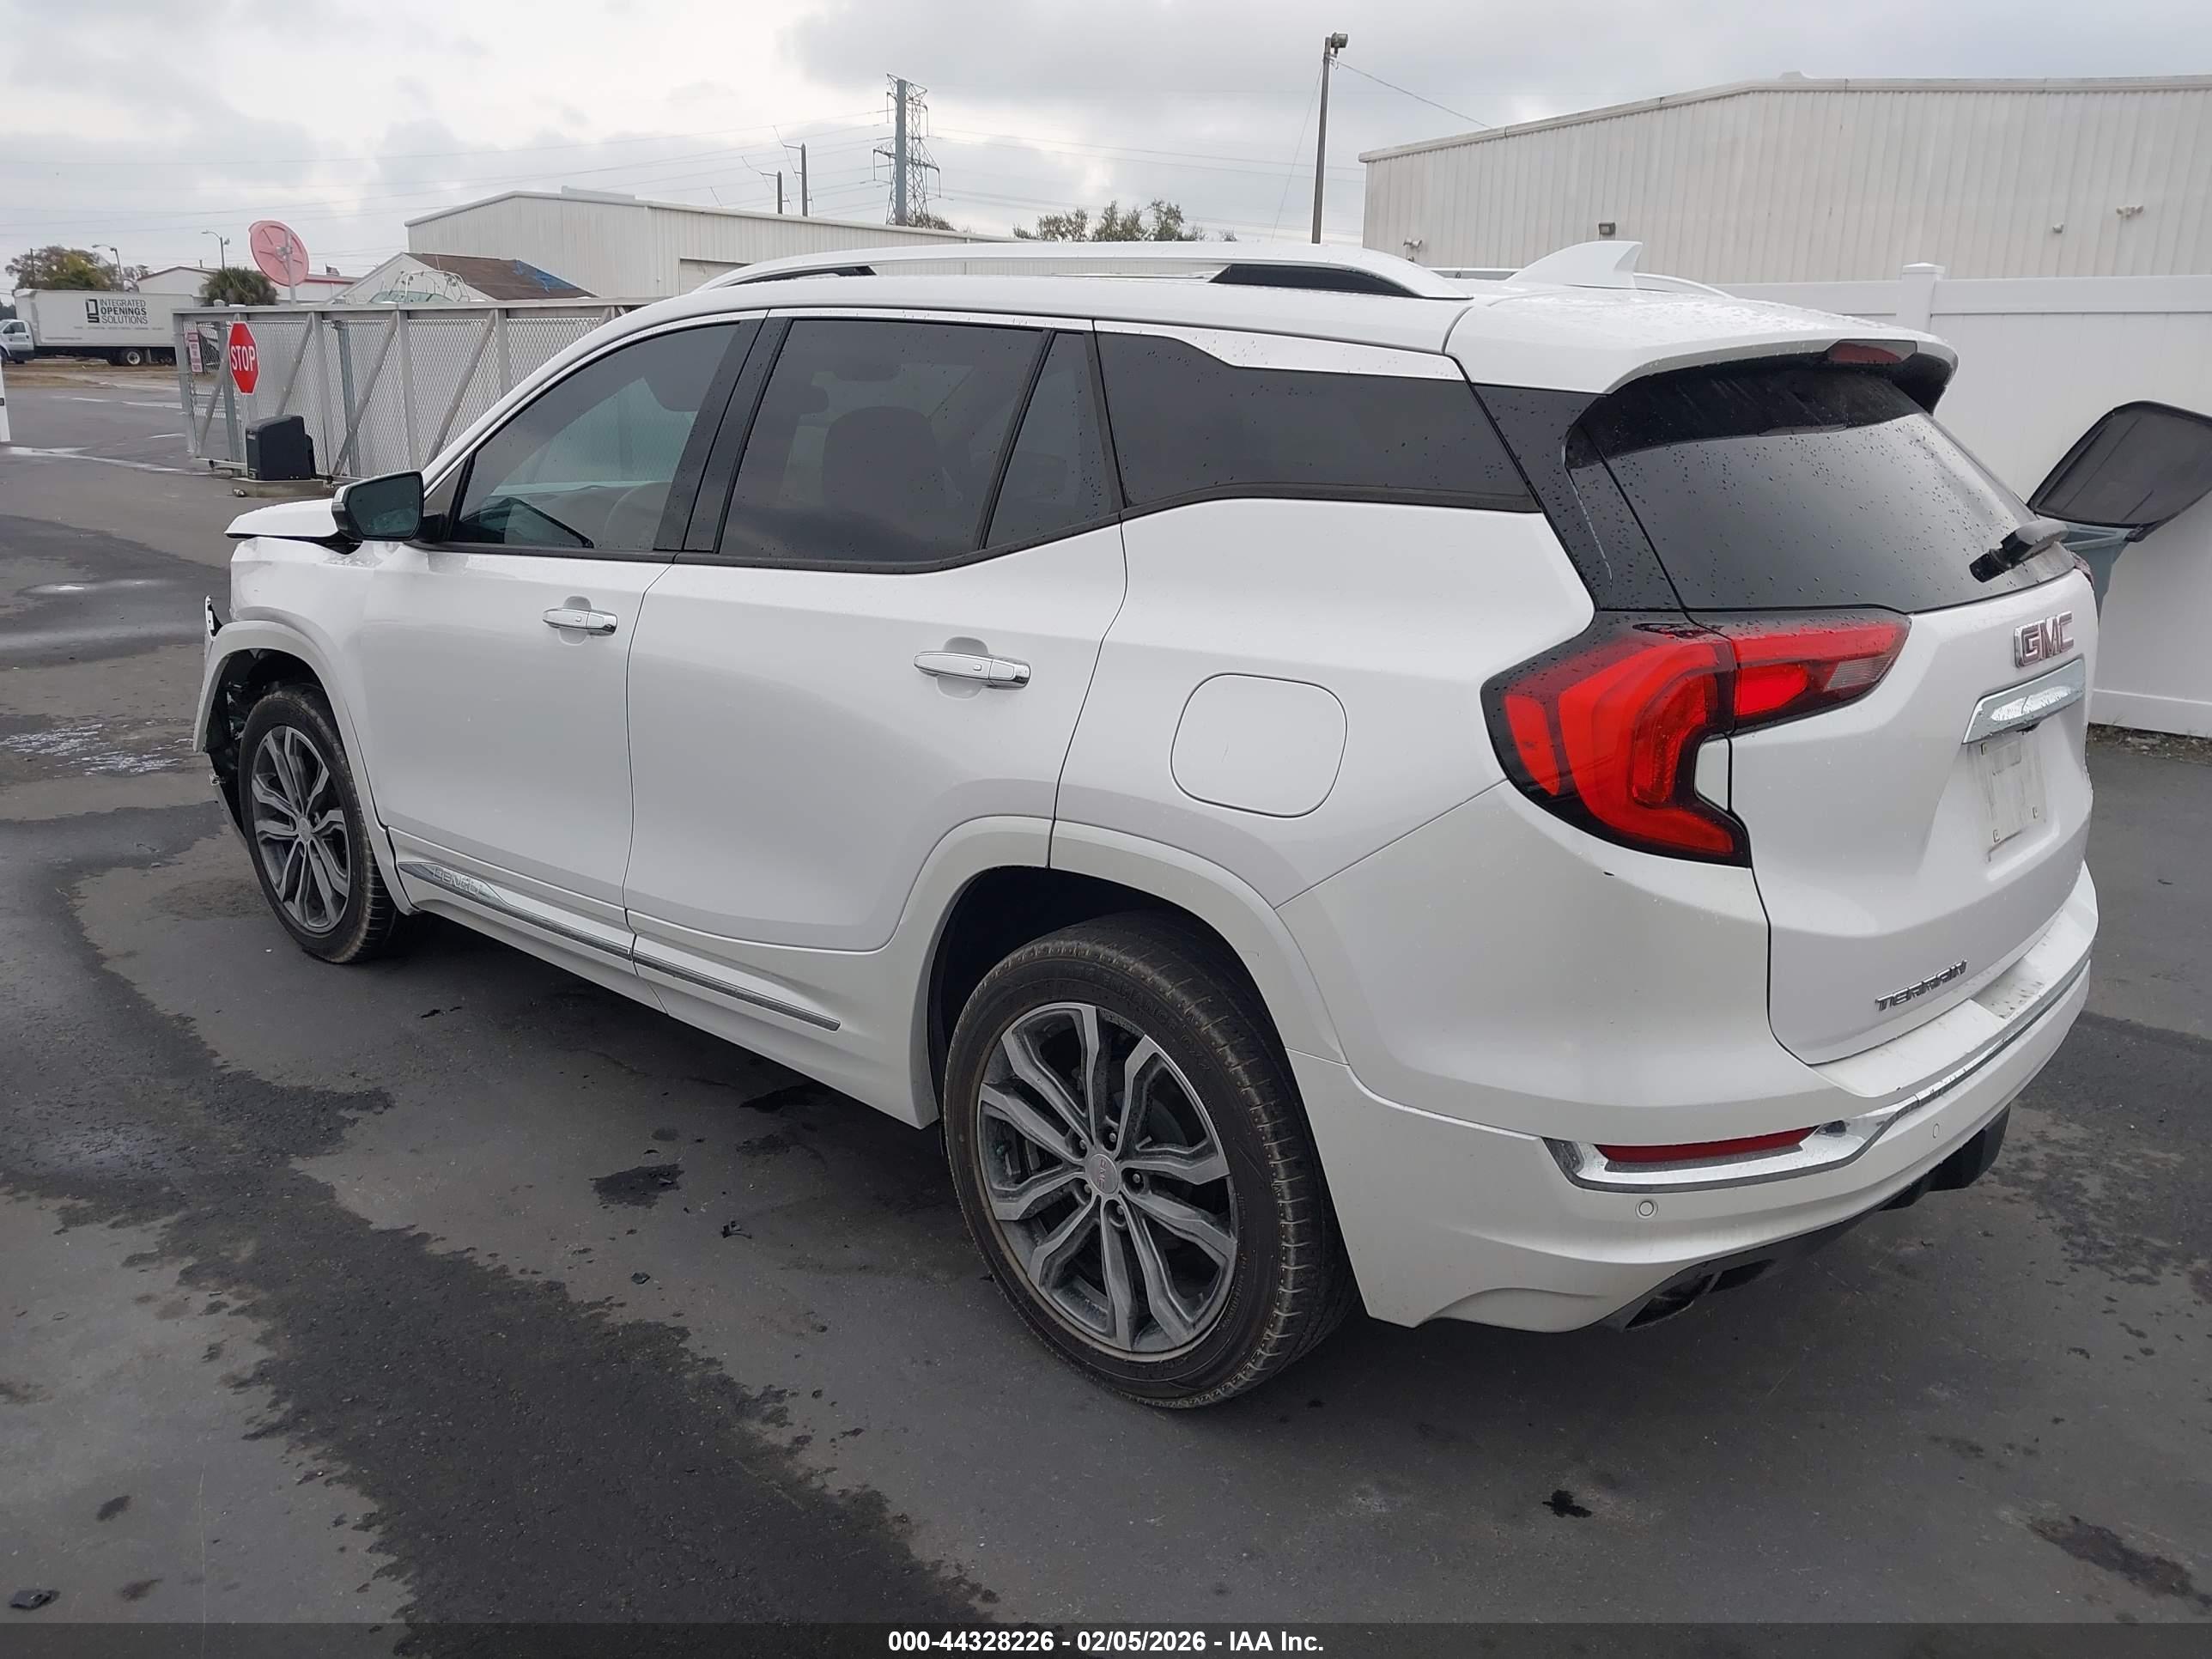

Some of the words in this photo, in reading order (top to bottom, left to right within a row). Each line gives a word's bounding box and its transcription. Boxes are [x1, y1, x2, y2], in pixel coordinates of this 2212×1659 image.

[100, 299, 146, 307] INTEGRATED
[100, 307, 147, 316] OPENINGS
[101, 315, 149, 325] SOLUTIONS
[230, 345, 256, 372] STOP
[2014, 611, 2075, 668] GMC
[1875, 959, 1967, 1012] TERRAIN
